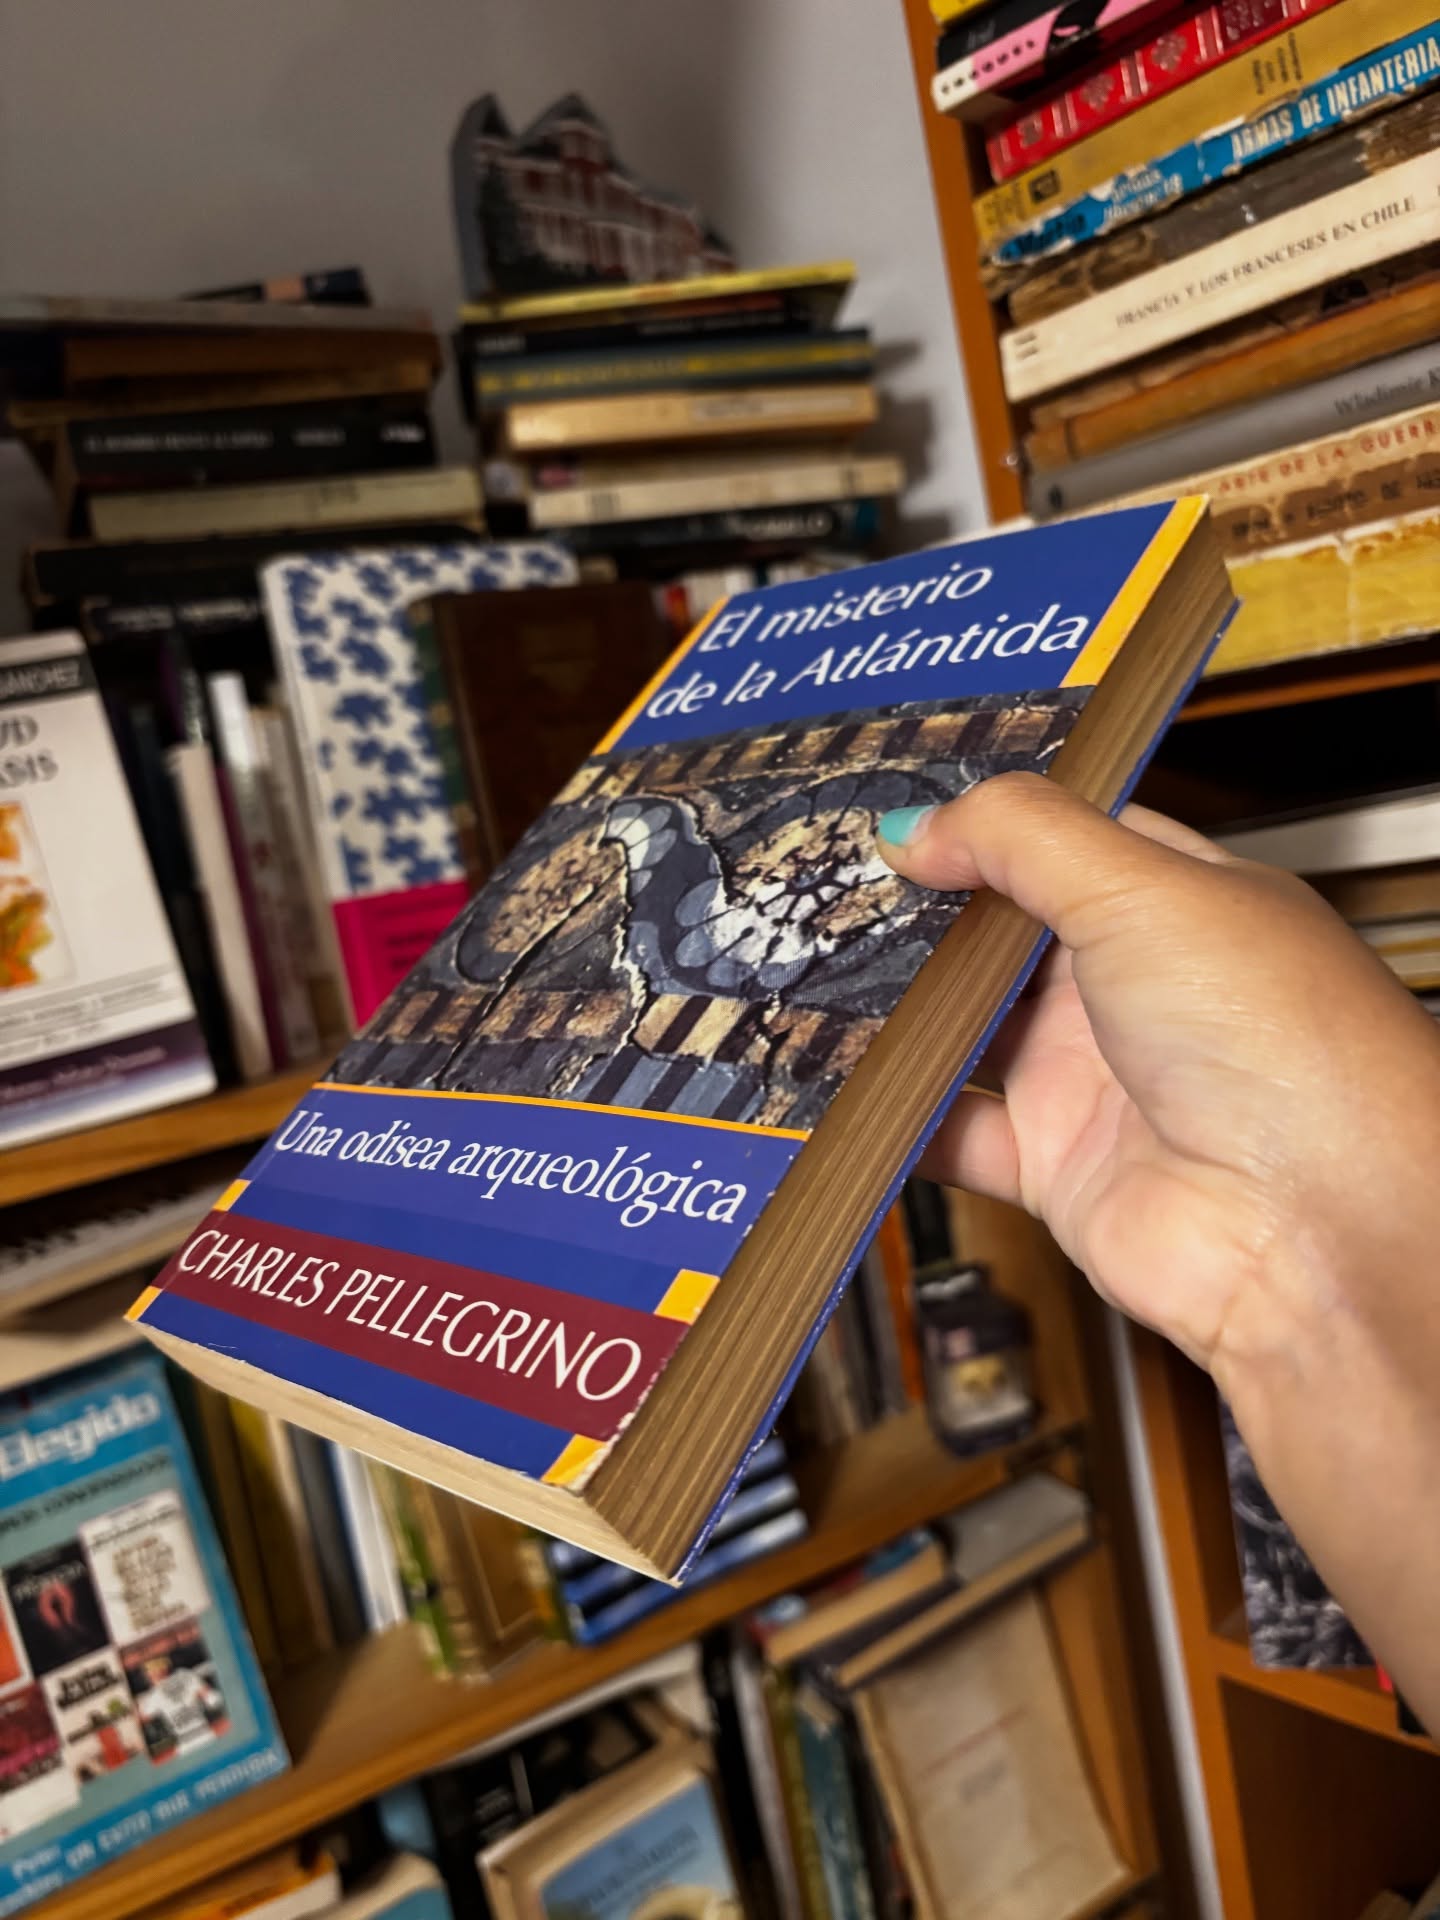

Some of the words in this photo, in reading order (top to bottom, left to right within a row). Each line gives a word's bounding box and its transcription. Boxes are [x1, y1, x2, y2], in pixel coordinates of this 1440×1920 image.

[1231, 109, 1294, 160] ARMAS
[1299, 93, 1325, 129] DE
[1326, 36, 1440, 117] INFANTERIA
[1200, 270, 1230, 294] LOS
[1232, 230, 1329, 279] FRANCESES
[1332, 221, 1359, 242] EN
[1360, 193, 1419, 231] CHILE
[646, 671, 718, 719] de
[722, 660, 778, 706] la
[780, 602, 1090, 693] Atlántida
[698, 604, 763, 653] El
[757, 562, 994, 643] misterio
[273, 1110, 343, 1157] Una
[341, 1119, 451, 1171] odisea
[447, 1145, 748, 1229] arqueológica
[178, 1228, 340, 1308] CHARLES
[324, 1267, 643, 1402] PELLEGRINO
